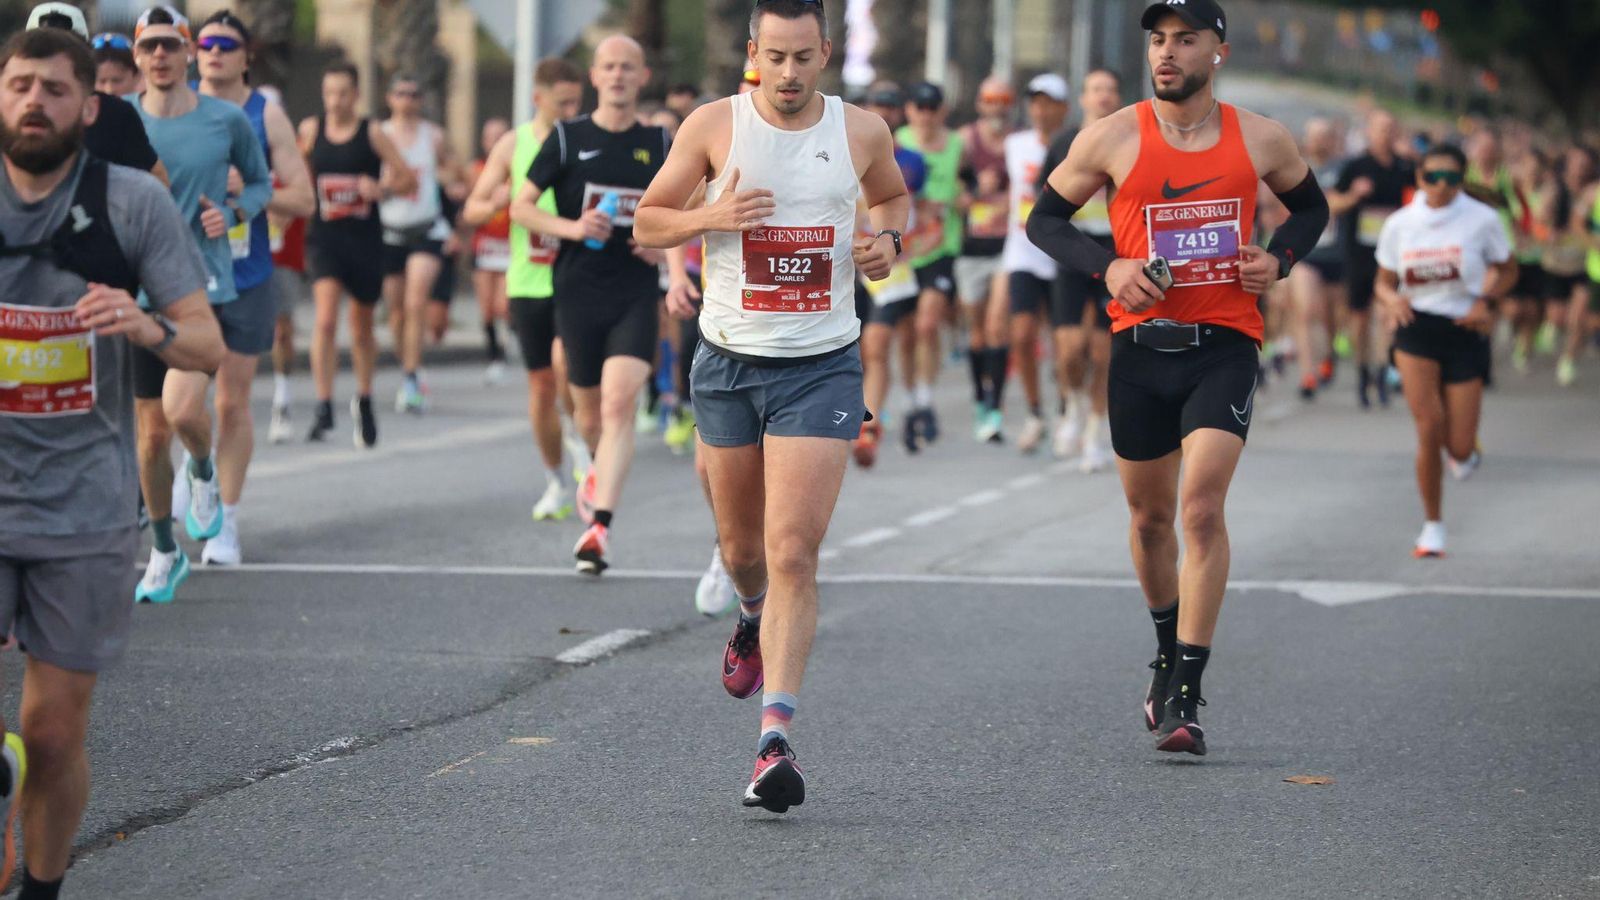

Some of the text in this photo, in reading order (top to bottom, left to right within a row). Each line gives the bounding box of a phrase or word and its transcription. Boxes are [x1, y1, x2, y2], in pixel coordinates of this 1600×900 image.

[1174, 204, 1233, 219] GENERALI
[768, 229, 829, 242] GENERALI
[1174, 231, 1218, 248] 7419
[767, 257, 812, 273] 1522
[5, 345, 63, 368] 7492
